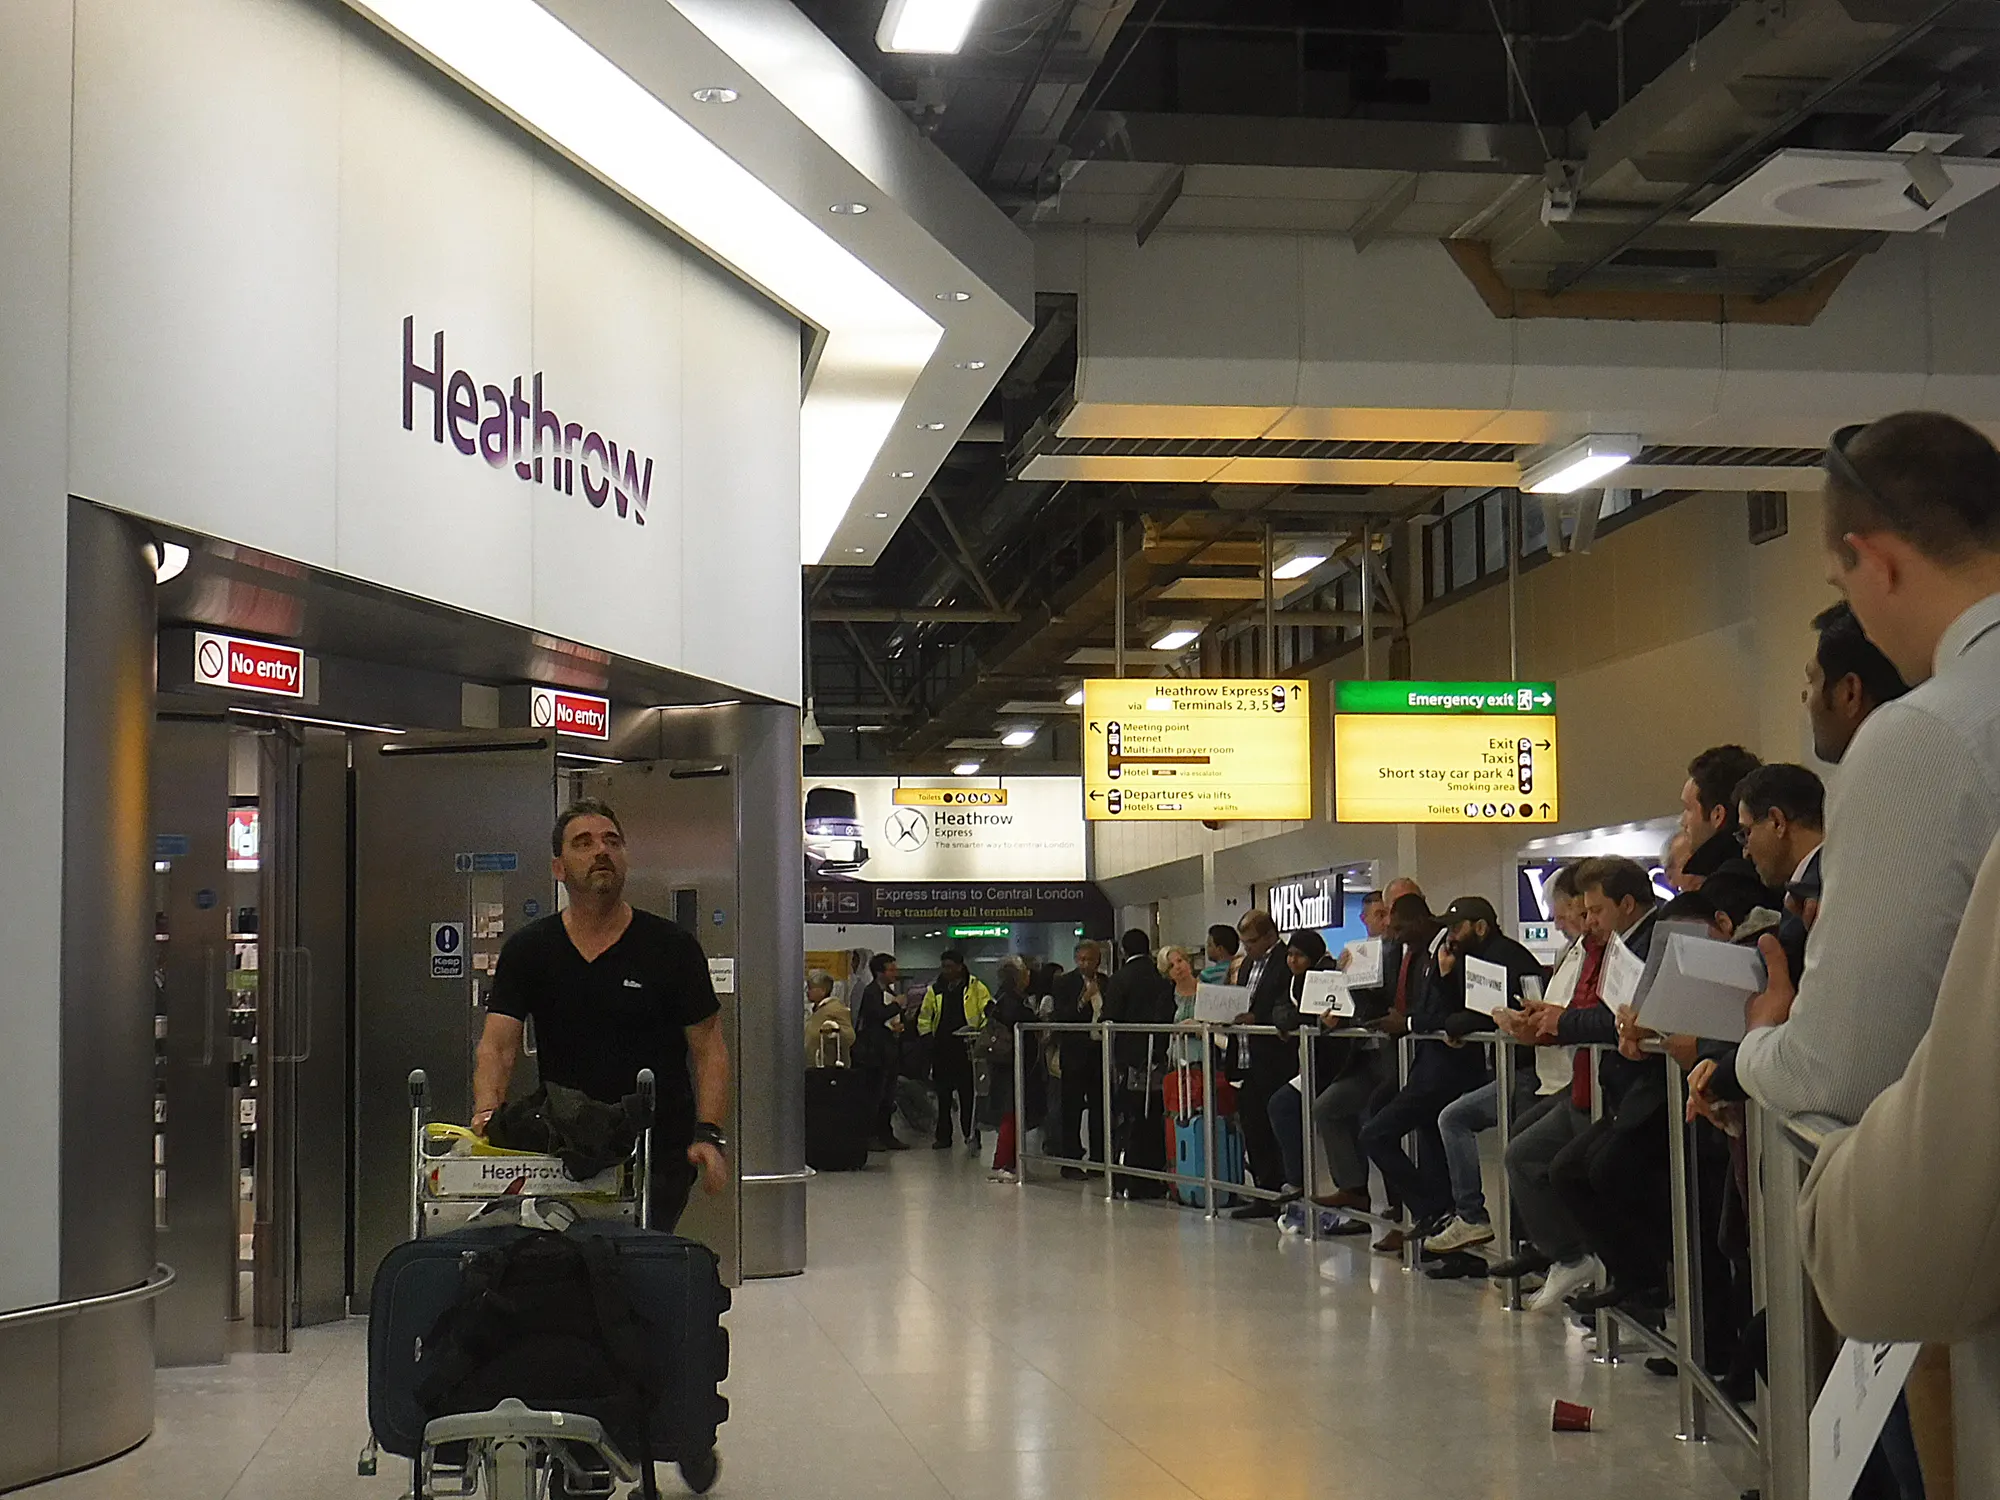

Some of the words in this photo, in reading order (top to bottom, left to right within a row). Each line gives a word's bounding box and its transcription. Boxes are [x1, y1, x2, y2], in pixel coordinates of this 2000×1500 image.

[403, 314, 653, 525] Heathrow
[232, 652, 254, 675] No
[257, 661, 297, 686] entry
[1155, 686, 1218, 697] Heathrow
[1222, 687, 1269, 699] Express
[1128, 702, 1142, 710] via
[1173, 700, 1232, 711] Terminals
[1408, 693, 1484, 708] Emergency
[1487, 693, 1514, 707] exit
[557, 703, 573, 722] No
[575, 710, 604, 731] entry
[1123, 723, 1163, 733] Meeting
[1165, 723, 1189, 733] point
[1123, 735, 1162, 743] Internet
[1489, 739, 1514, 749] Exit
[1123, 745, 1174, 755] Multi-faith
[1176, 747, 1207, 756] prayer
[1482, 753, 1514, 764] Taxis
[1123, 769, 1149, 777] Hotel
[1379, 768, 1414, 779] Short
[1419, 769, 1446, 782] stay
[1450, 771, 1469, 779] car
[1474, 768, 1503, 782] park
[1507, 768, 1514, 778] 4
[1447, 783, 1490, 792] Smoking
[1493, 784, 1515, 792] area
[1124, 790, 1194, 802] Departures
[1197, 792, 1212, 800] via
[1213, 791, 1232, 800] lifts
[1124, 803, 1154, 812] Hotels
[1428, 805, 1460, 814] Toilets
[934, 811, 1013, 825] Heathrow
[934, 828, 973, 838] Express
[876, 888, 926, 901] Express
[931, 888, 966, 900] trains
[969, 888, 981, 900] to
[986, 888, 1032, 900] Central
[1036, 888, 1084, 900] London
[1270, 879, 1332, 932] WHSmith
[876, 907, 902, 917] Free
[904, 906, 948, 917] transfer
[950, 908, 960, 917] to
[963, 907, 976, 917] all
[980, 906, 1034, 917] terminals
[434, 957, 460, 966] Keep
